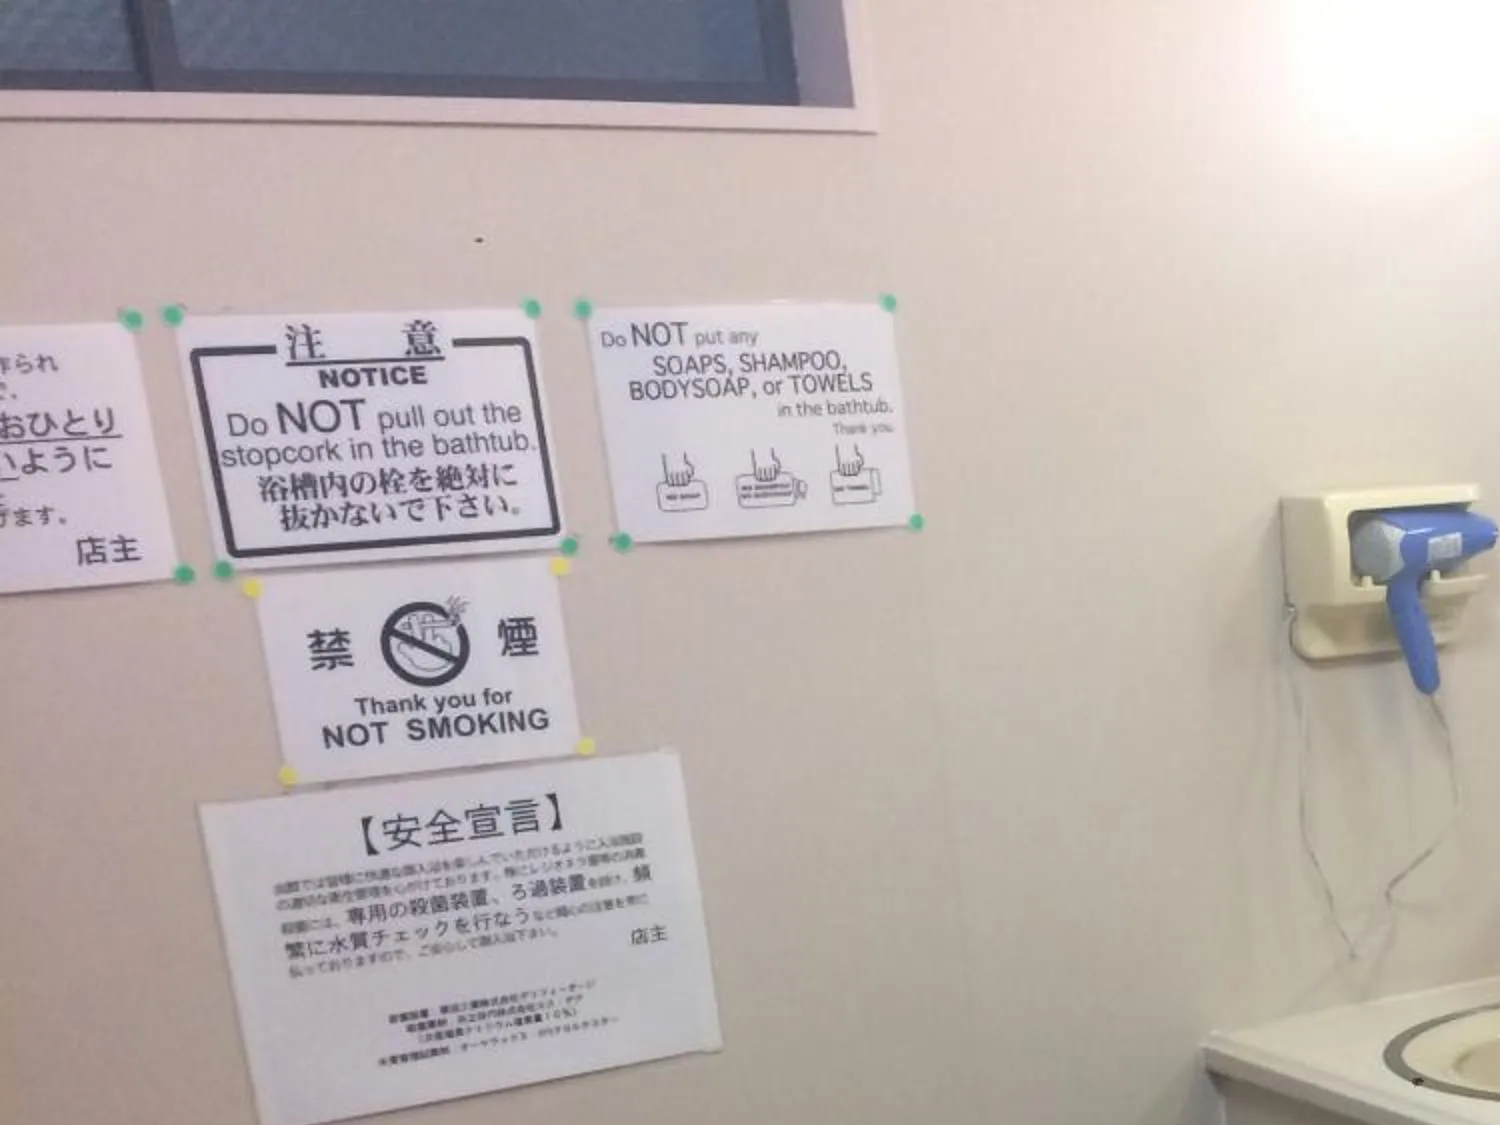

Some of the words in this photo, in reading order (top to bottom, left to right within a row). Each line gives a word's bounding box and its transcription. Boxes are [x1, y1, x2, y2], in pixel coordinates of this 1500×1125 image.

[285, 323, 326, 360] 注
[401, 319, 443, 356] 意
[601, 332, 627, 348] Do
[631, 322, 689, 347] NOT
[695, 330, 724, 347] put
[729, 331, 759, 348] any
[318, 366, 428, 389] NOTICE
[653, 354, 733, 378] SOAPS,
[739, 350, 848, 374] SHAMPOO,
[629, 378, 757, 401] BODYSOAP,
[762, 381, 783, 395] or
[787, 372, 873, 394] TOWELS
[227, 413, 269, 437] Do
[276, 398, 366, 435] NOT
[377, 404, 425, 435] pull
[433, 405, 477, 427] out
[481, 401, 522, 424] the
[777, 404, 793, 418] in
[796, 402, 822, 416] the
[826, 399, 894, 416] bathtub.
[221, 438, 343, 471] stopcork
[348, 437, 373, 461] in
[381, 435, 424, 459] the
[431, 431, 538, 456] bathtub.
[257, 463, 519, 503] 浴槽内の栓を絶対に
[280, 493, 520, 532] 抜かないで下さい。
[76, 533, 142, 566] 店主
[307, 627, 354, 671] 禁
[498, 616, 539, 657] 煙
[354, 694, 427, 716] Thank
[434, 692, 476, 713] you
[483, 688, 512, 705] for
[322, 721, 388, 749] NOT
[407, 708, 549, 741] SMOKING
[630, 924, 668, 946] 店主
